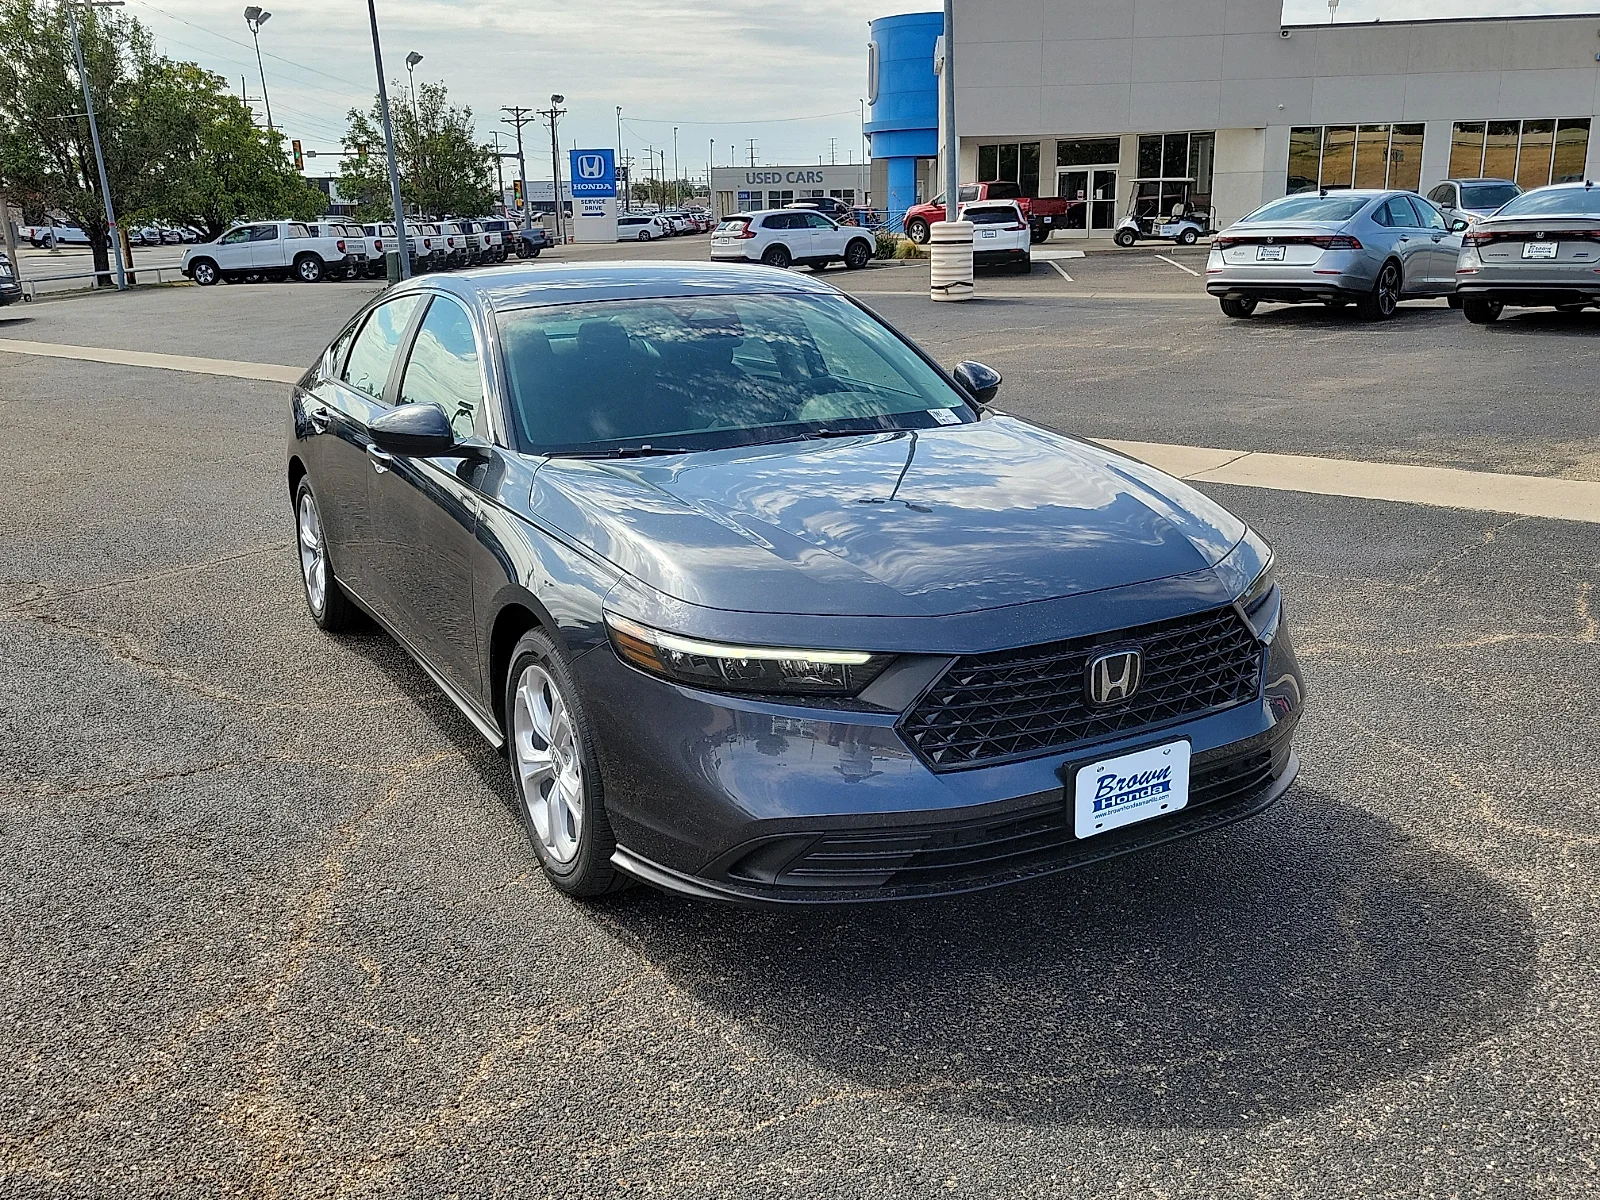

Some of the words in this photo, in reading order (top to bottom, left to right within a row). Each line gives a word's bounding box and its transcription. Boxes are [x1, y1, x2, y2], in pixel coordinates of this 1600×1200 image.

[745, 172, 782, 184] USED
[786, 170, 824, 184] CARS
[1094, 764, 1172, 800] Brown
[1101, 784, 1163, 809] Honda
